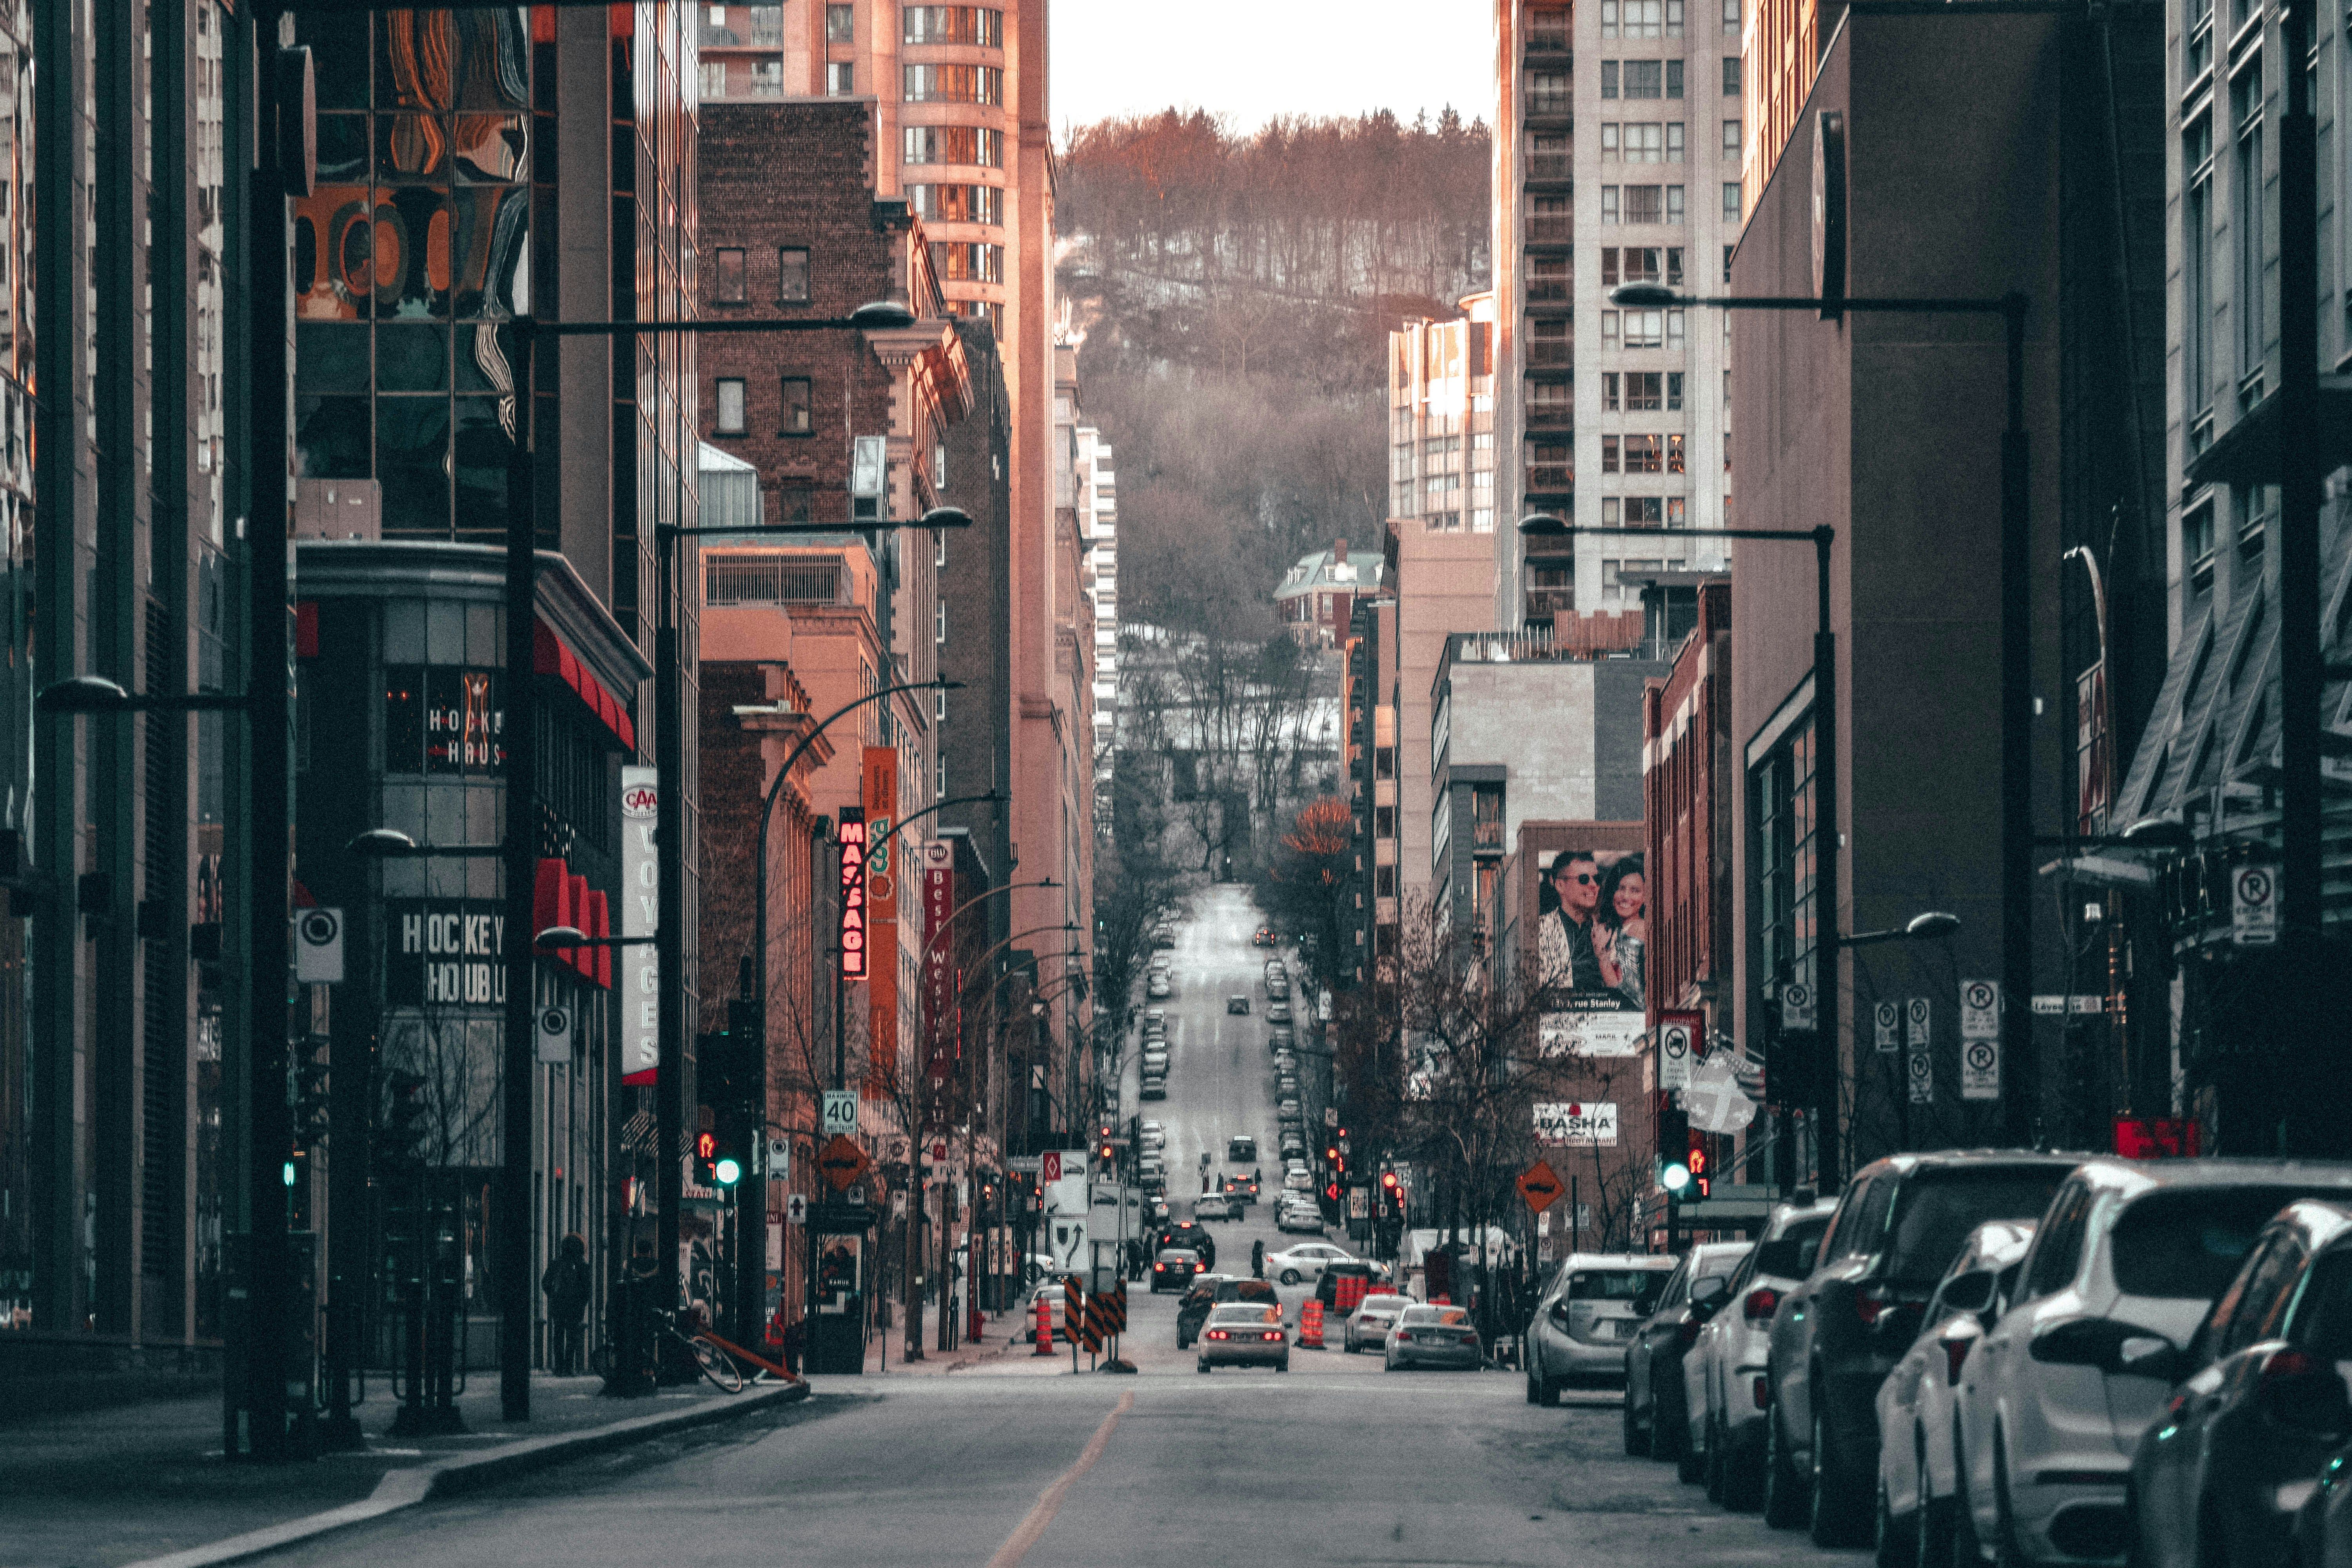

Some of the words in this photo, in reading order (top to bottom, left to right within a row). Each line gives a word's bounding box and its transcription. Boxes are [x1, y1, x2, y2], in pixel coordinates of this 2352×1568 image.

[448, 742, 500, 766] HAUS
[626, 788, 657, 810] CAA
[840, 823, 863, 971] MASSAGE
[933, 871, 943, 933] Best
[403, 913, 504, 955] HOCKEY
[640, 826, 658, 1064] VOYAGES
[1575, 999, 1588, 1008] rue
[1590, 998, 1620, 1010] Stanley
[827, 1101, 854, 1123] 40
[1540, 1116, 1610, 1129] BASHA
